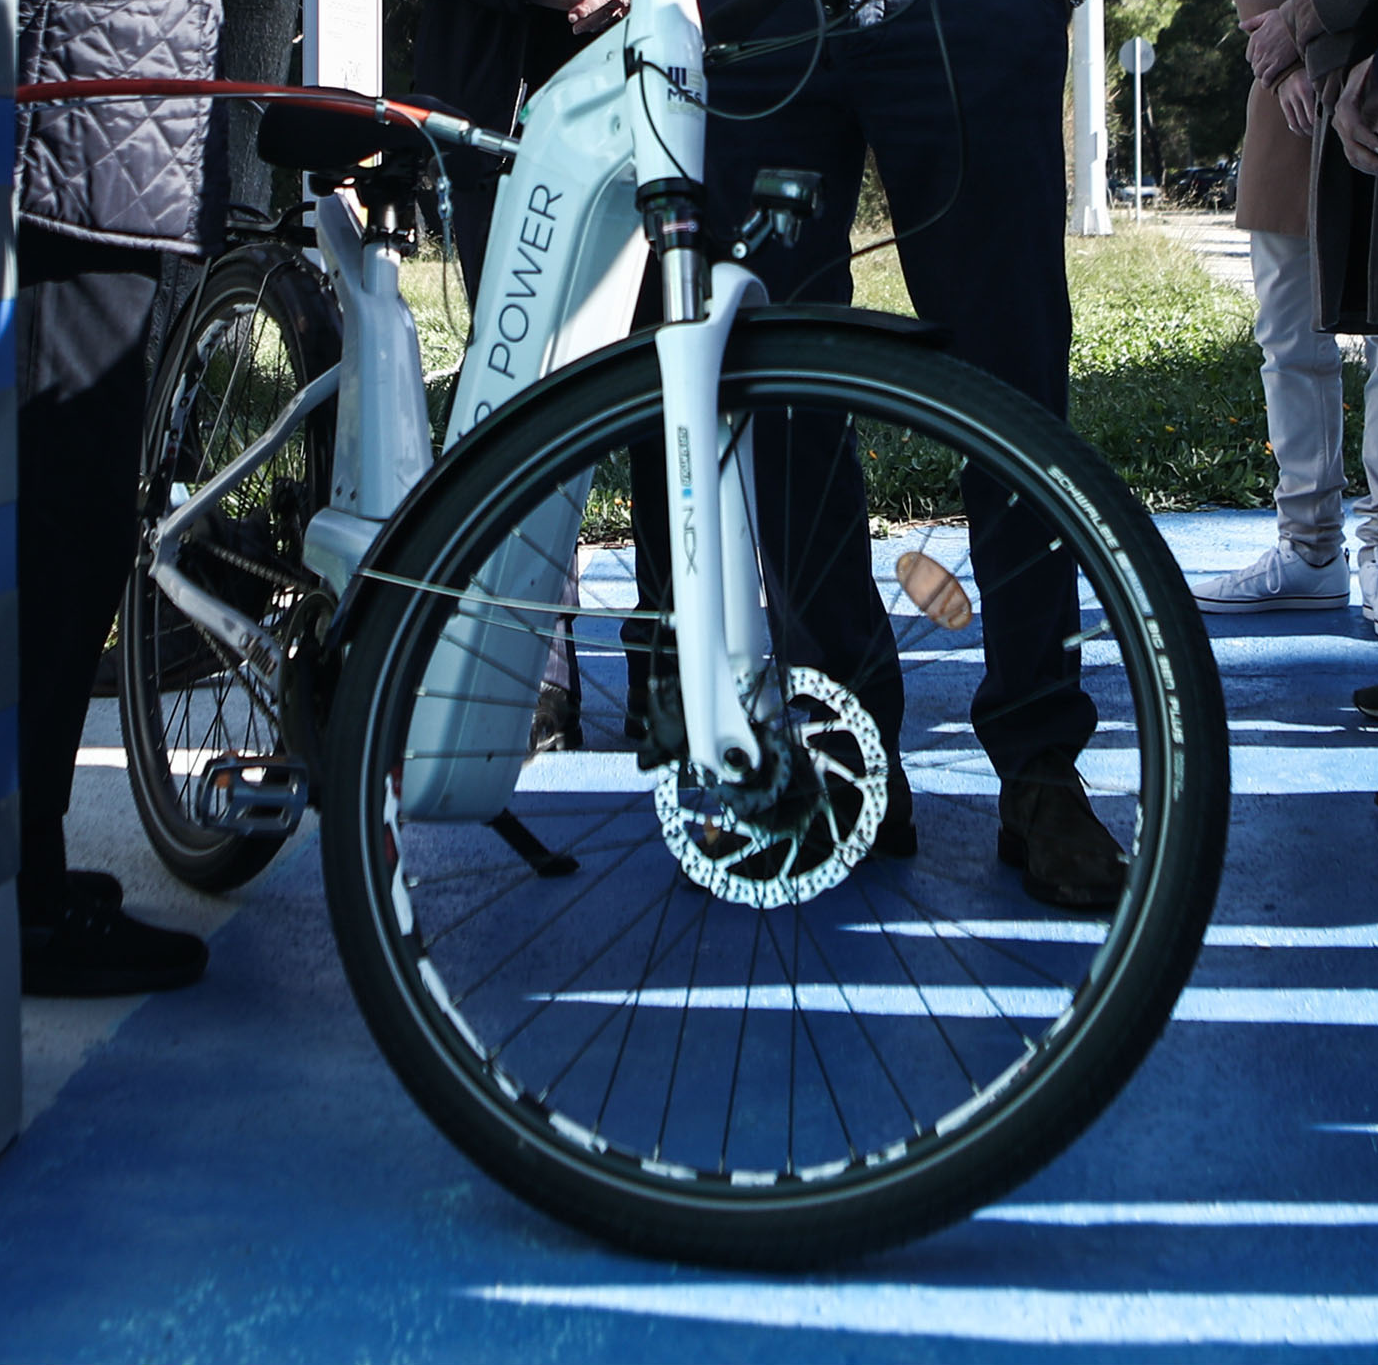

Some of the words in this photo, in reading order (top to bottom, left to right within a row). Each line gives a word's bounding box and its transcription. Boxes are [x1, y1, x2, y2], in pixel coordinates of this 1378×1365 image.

[488, 184, 563, 380] POWER
[1047, 465, 1120, 549] SCHWALBE
[1168, 695, 1185, 744] PLUS
